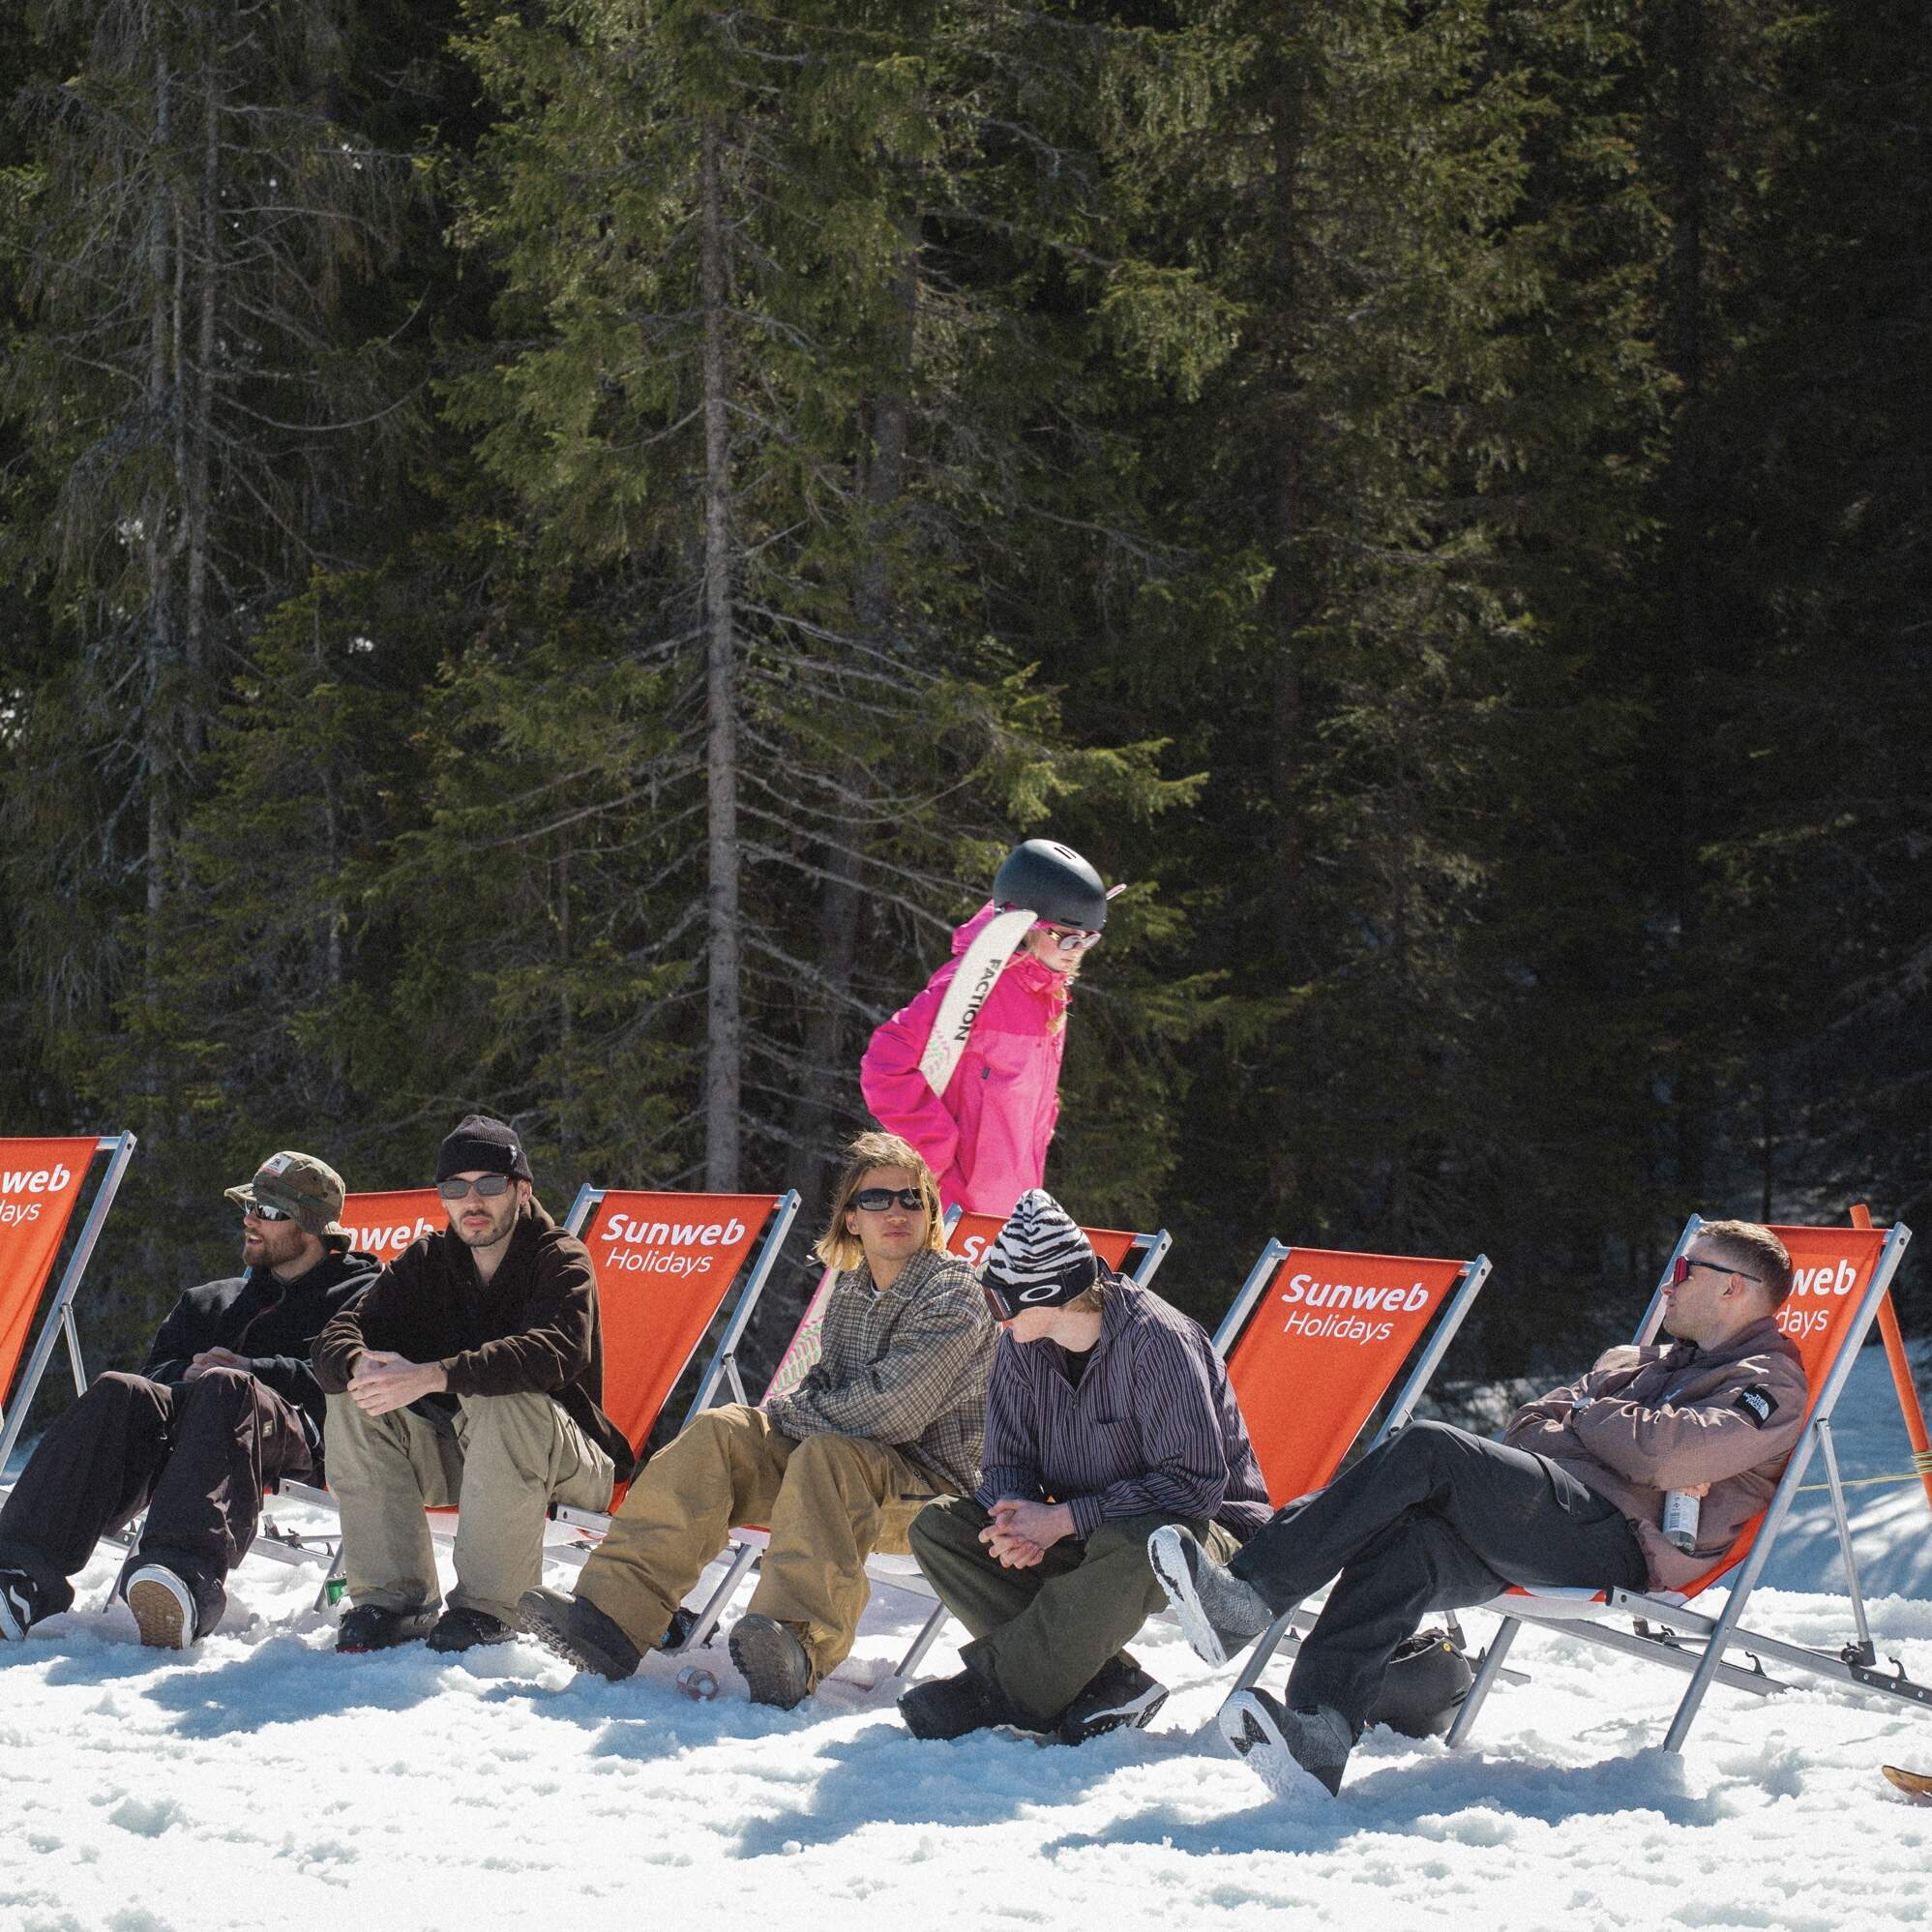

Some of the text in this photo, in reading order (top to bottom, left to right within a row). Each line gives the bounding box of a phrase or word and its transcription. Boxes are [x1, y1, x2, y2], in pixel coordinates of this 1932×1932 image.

[954, 959, 1002, 1041] FACTION
[601, 1213, 746, 1246] Sunweb
[606, 1246, 714, 1279] Holidays
[1281, 1273, 1429, 1312] Sunweb
[1284, 1310, 1394, 1346] Holidays
